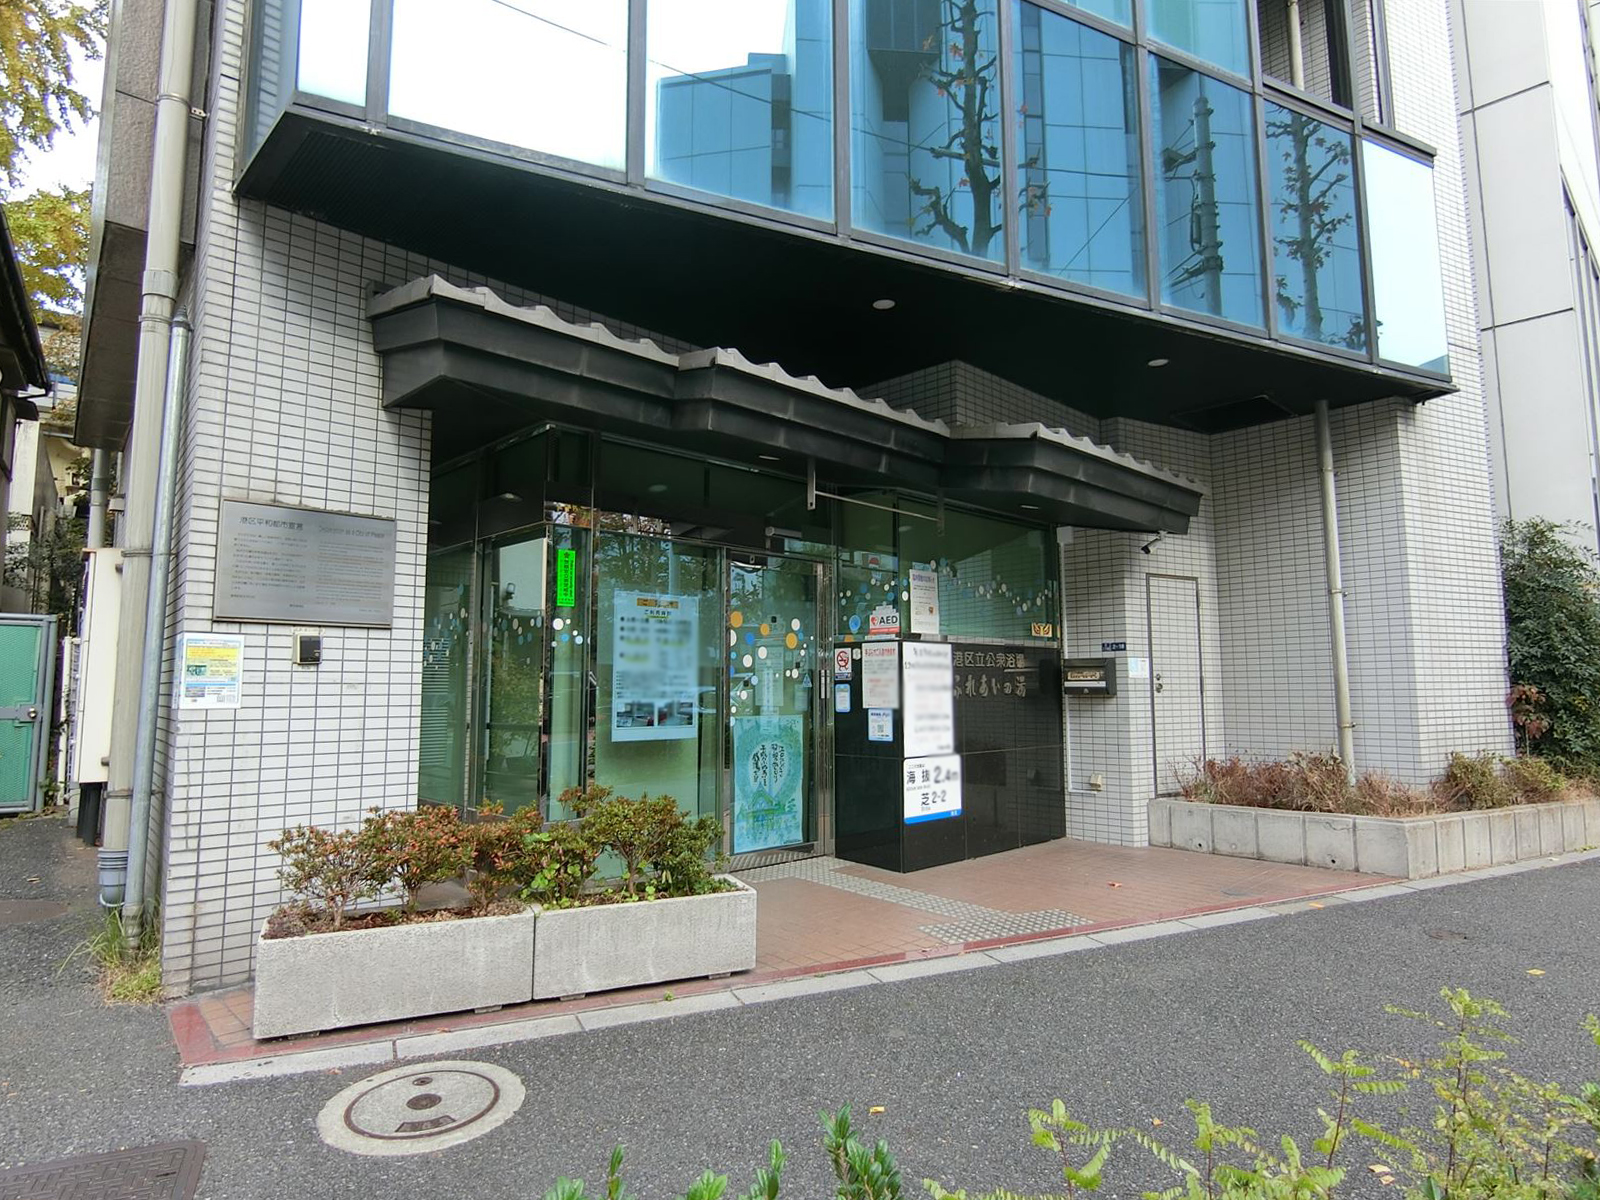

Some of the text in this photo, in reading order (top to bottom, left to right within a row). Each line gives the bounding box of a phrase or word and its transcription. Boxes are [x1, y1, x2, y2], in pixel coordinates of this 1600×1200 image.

[879, 615, 898, 625] AED
[953, 650, 1026, 668] 港区立公衆浴場
